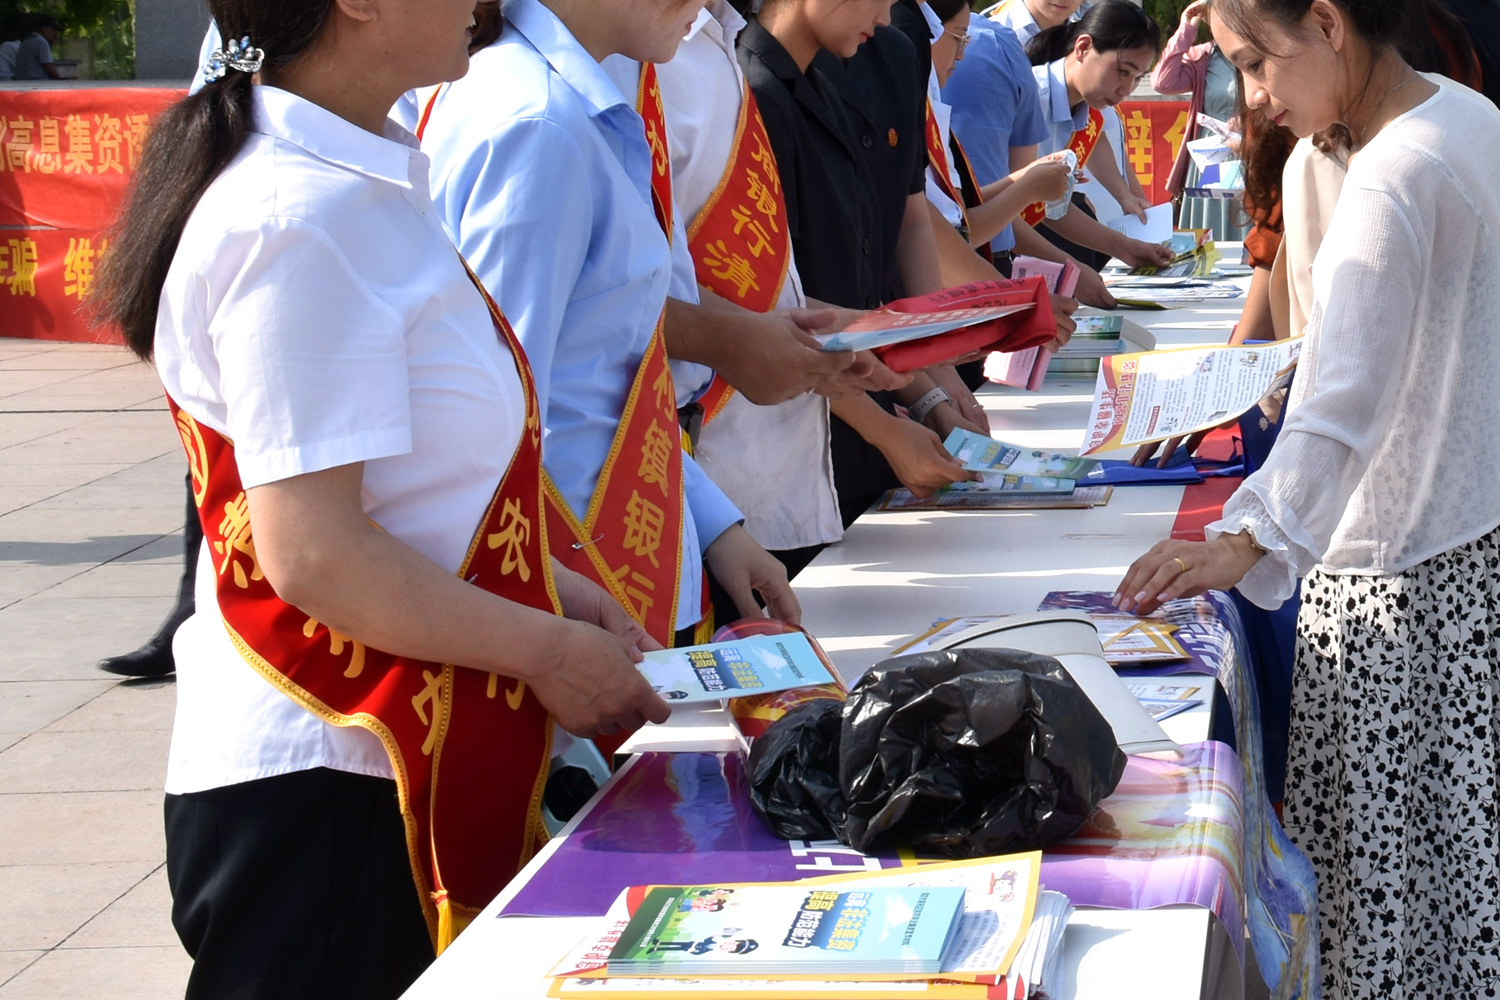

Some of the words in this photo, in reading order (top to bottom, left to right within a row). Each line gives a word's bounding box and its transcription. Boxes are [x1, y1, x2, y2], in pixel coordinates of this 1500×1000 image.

[0, 113, 150, 174] 高息集资
[703, 114, 780, 301] 商银行清
[0, 238, 38, 296] 骗
[64, 238, 109, 300] 维
[788, 891, 838, 947] 提高防范能力
